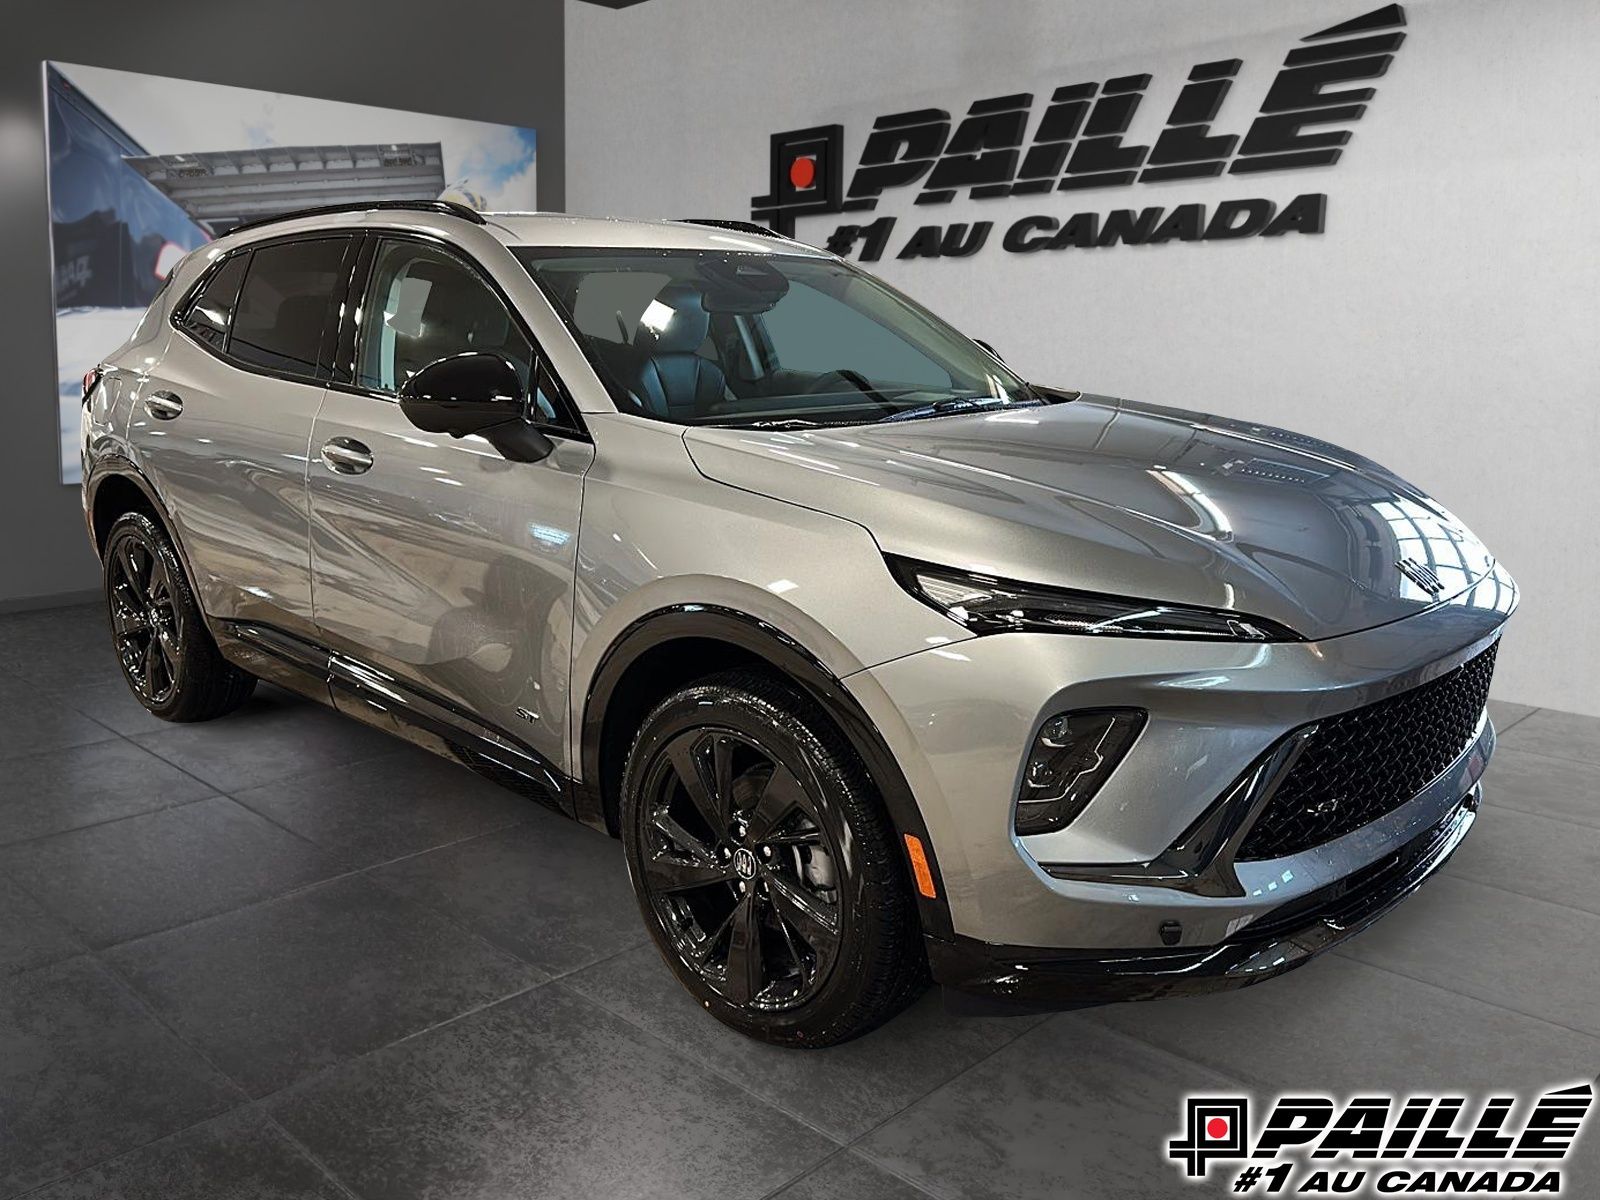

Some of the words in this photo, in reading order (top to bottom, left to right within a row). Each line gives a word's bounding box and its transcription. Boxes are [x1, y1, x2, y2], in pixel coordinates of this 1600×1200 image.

[843, 3, 1407, 212] PAILLÉ
[825, 216, 897, 262] #1
[896, 221, 994, 259] AU
[1002, 193, 1328, 253] CANADA
